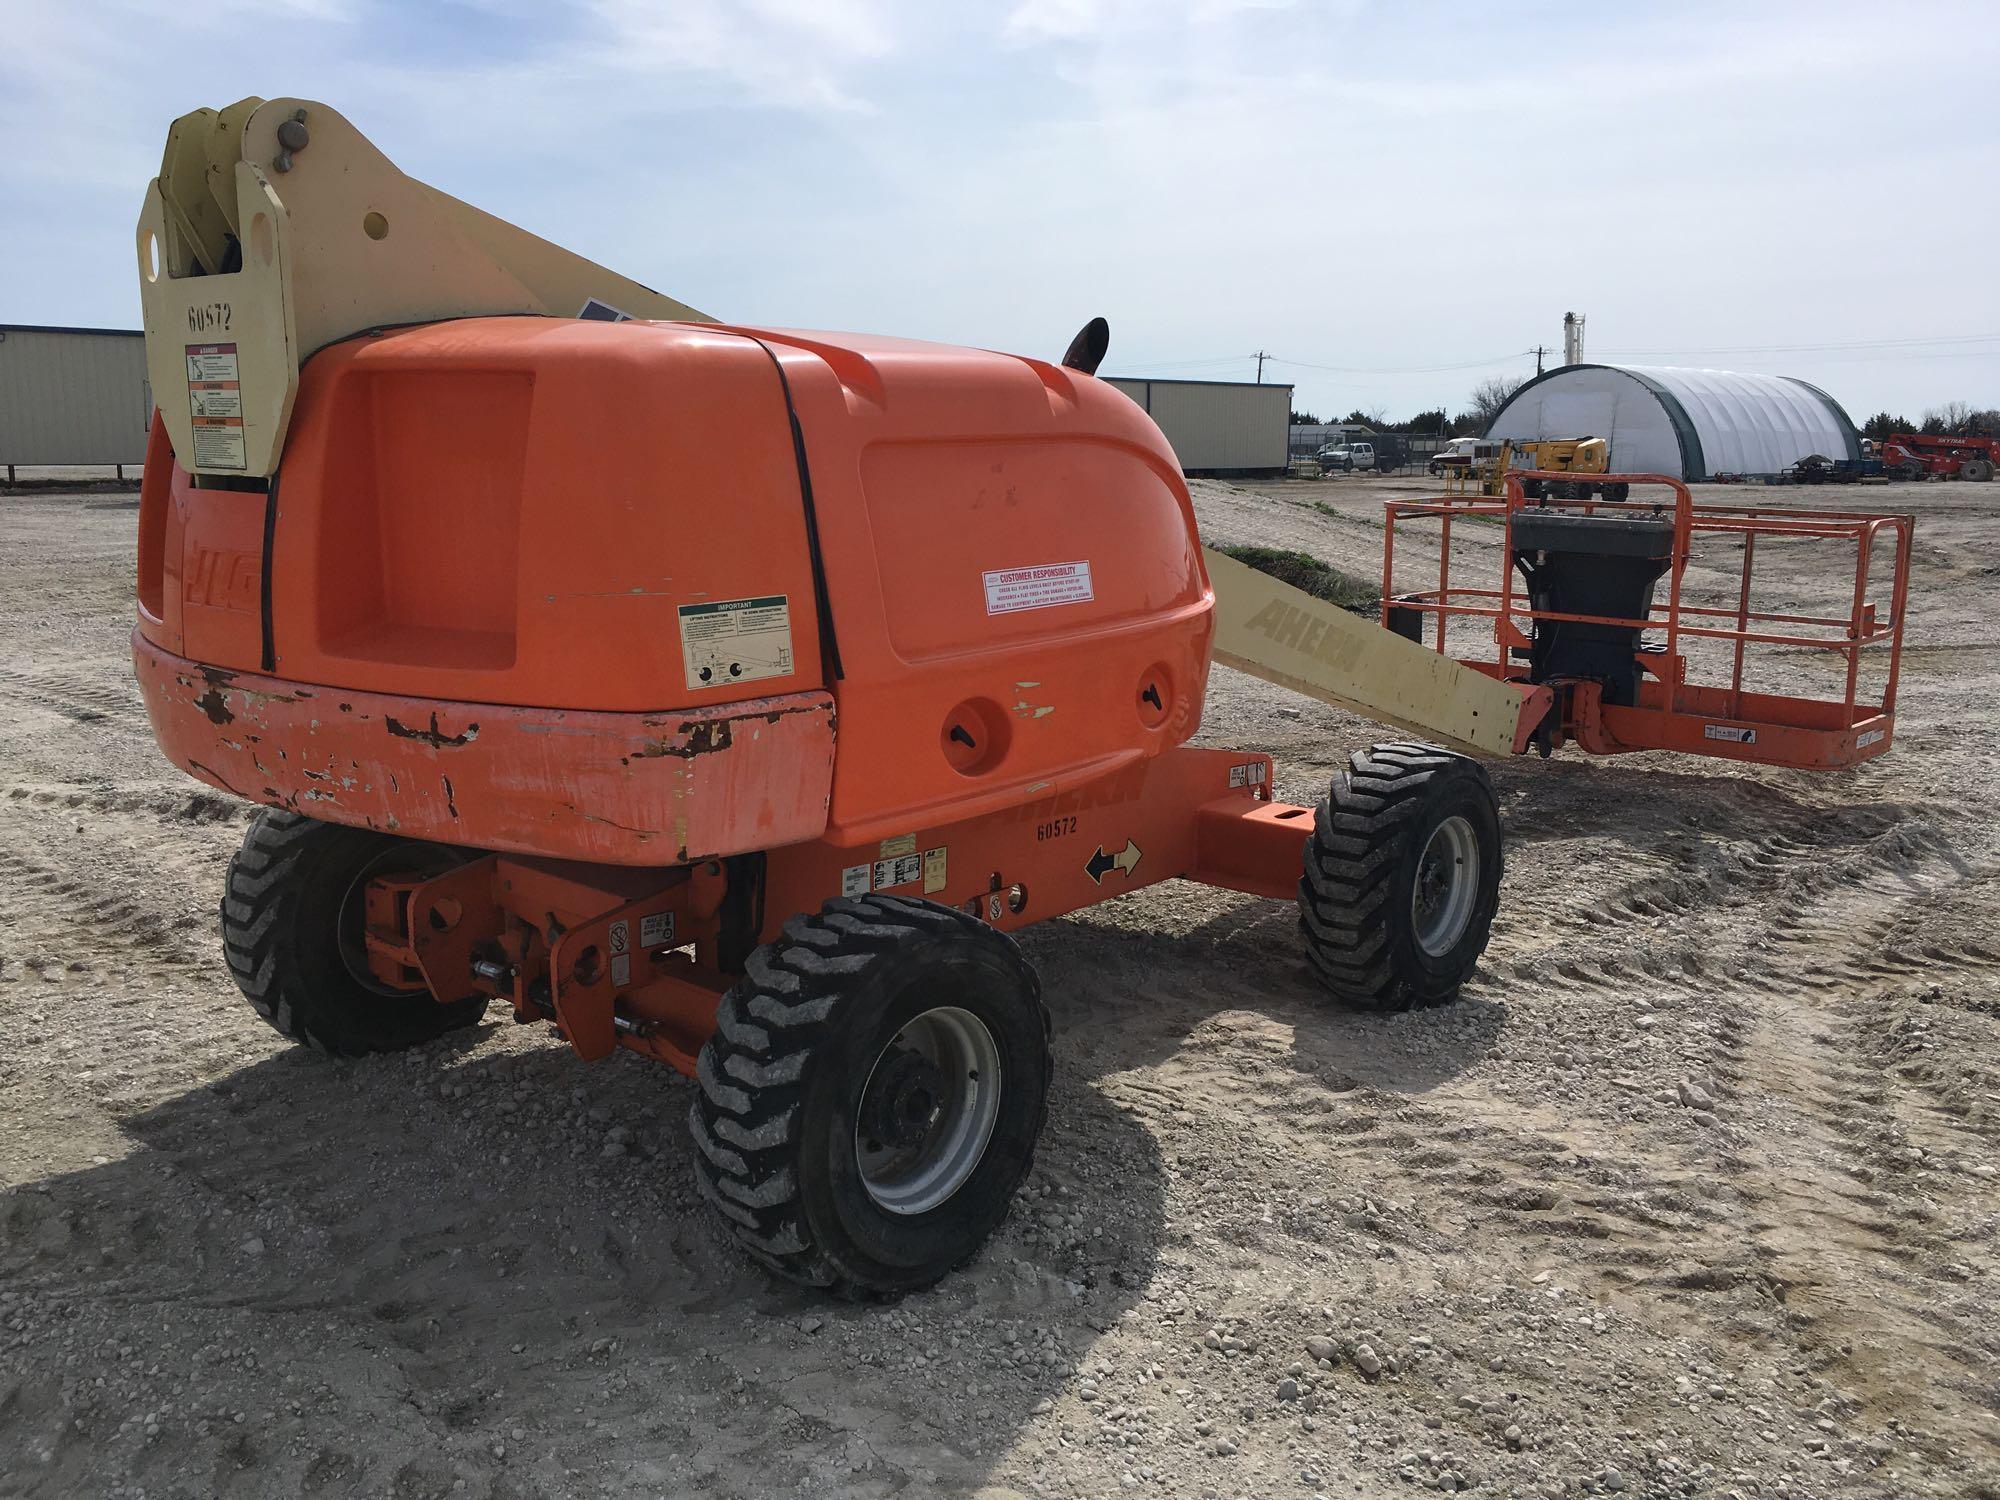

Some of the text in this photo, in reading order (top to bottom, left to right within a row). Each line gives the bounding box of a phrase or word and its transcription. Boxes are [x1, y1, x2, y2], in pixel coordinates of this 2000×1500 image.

[1000, 571, 1032, 583] CUSTOMER
[1033, 566, 1076, 579] RESPONSIBILITY
[717, 602, 752, 611] IMPORTANT
[1242, 599, 1368, 673] AHERN
[1037, 816, 1077, 841] 60572
